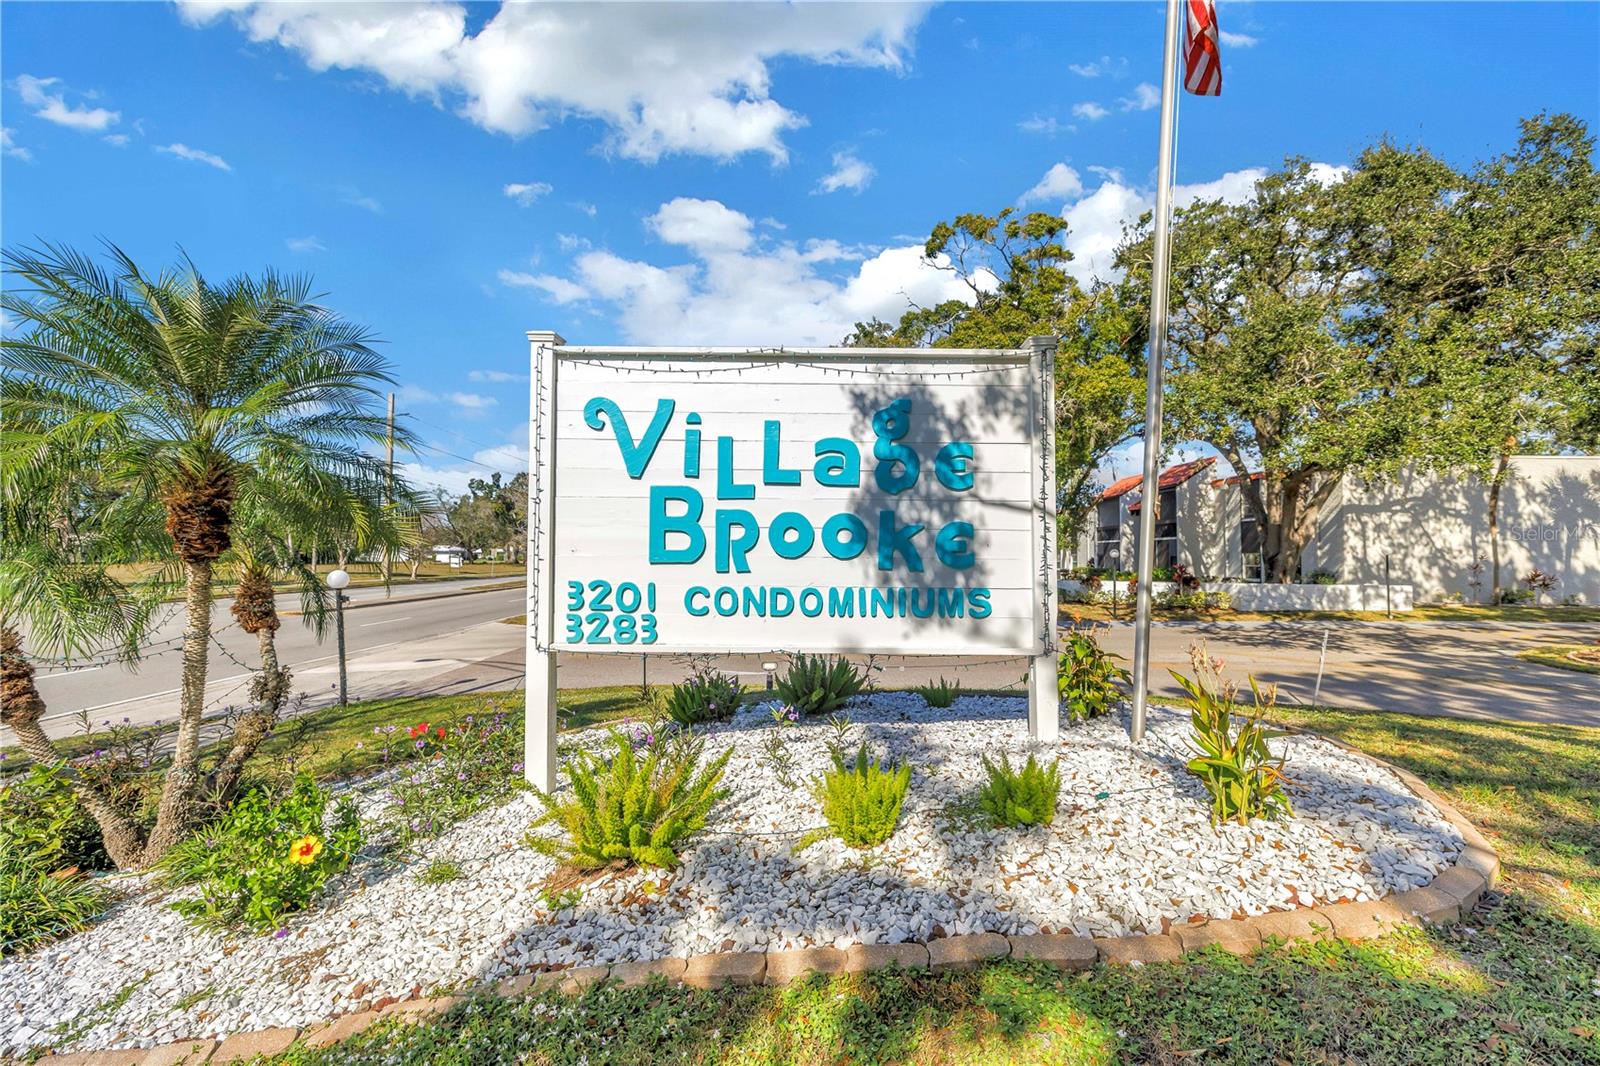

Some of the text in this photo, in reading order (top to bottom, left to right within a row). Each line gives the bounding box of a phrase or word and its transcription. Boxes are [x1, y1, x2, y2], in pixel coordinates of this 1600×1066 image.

[567, 581, 656, 613] 3201
[685, 587, 993, 619] CONDOMINIUMS
[566, 613, 658, 644] 3283
